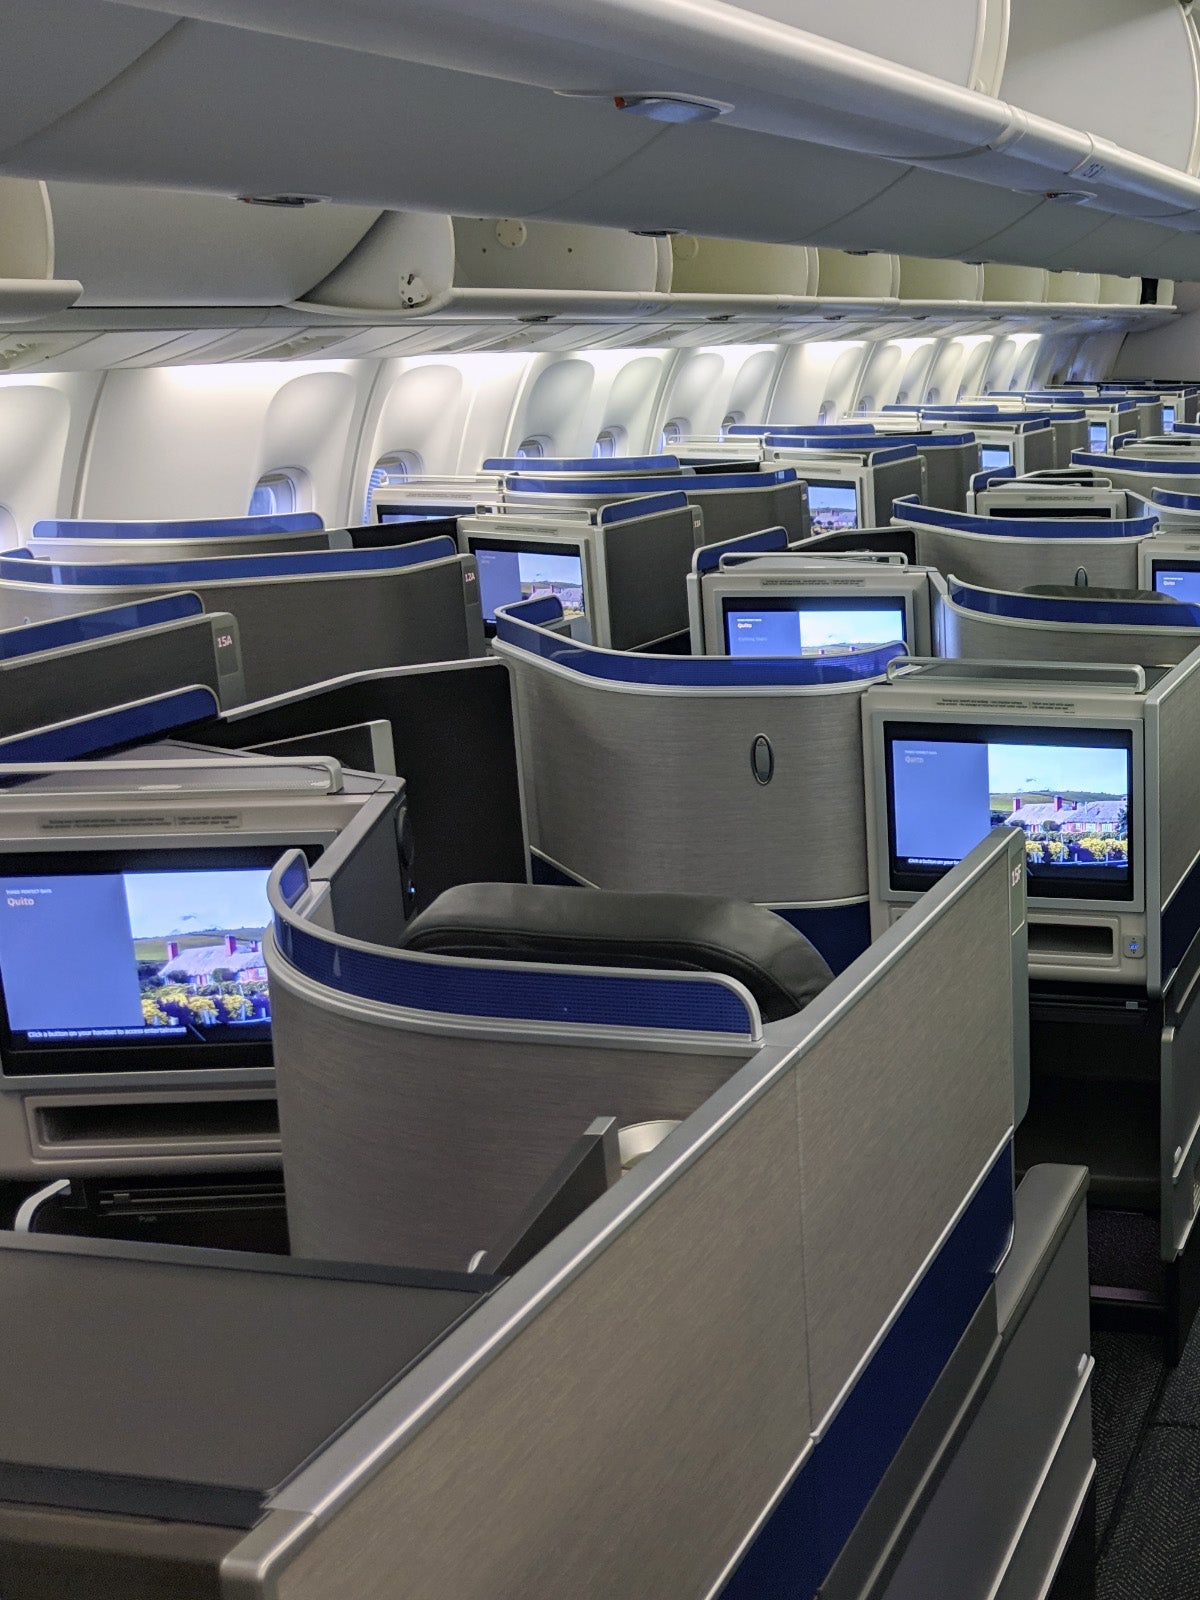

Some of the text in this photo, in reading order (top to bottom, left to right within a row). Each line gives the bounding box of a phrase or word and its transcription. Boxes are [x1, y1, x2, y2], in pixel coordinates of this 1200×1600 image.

[217, 635, 233, 648] 15A
[7, 897, 35, 907] Quito
[77, 1030, 92, 1038] your
